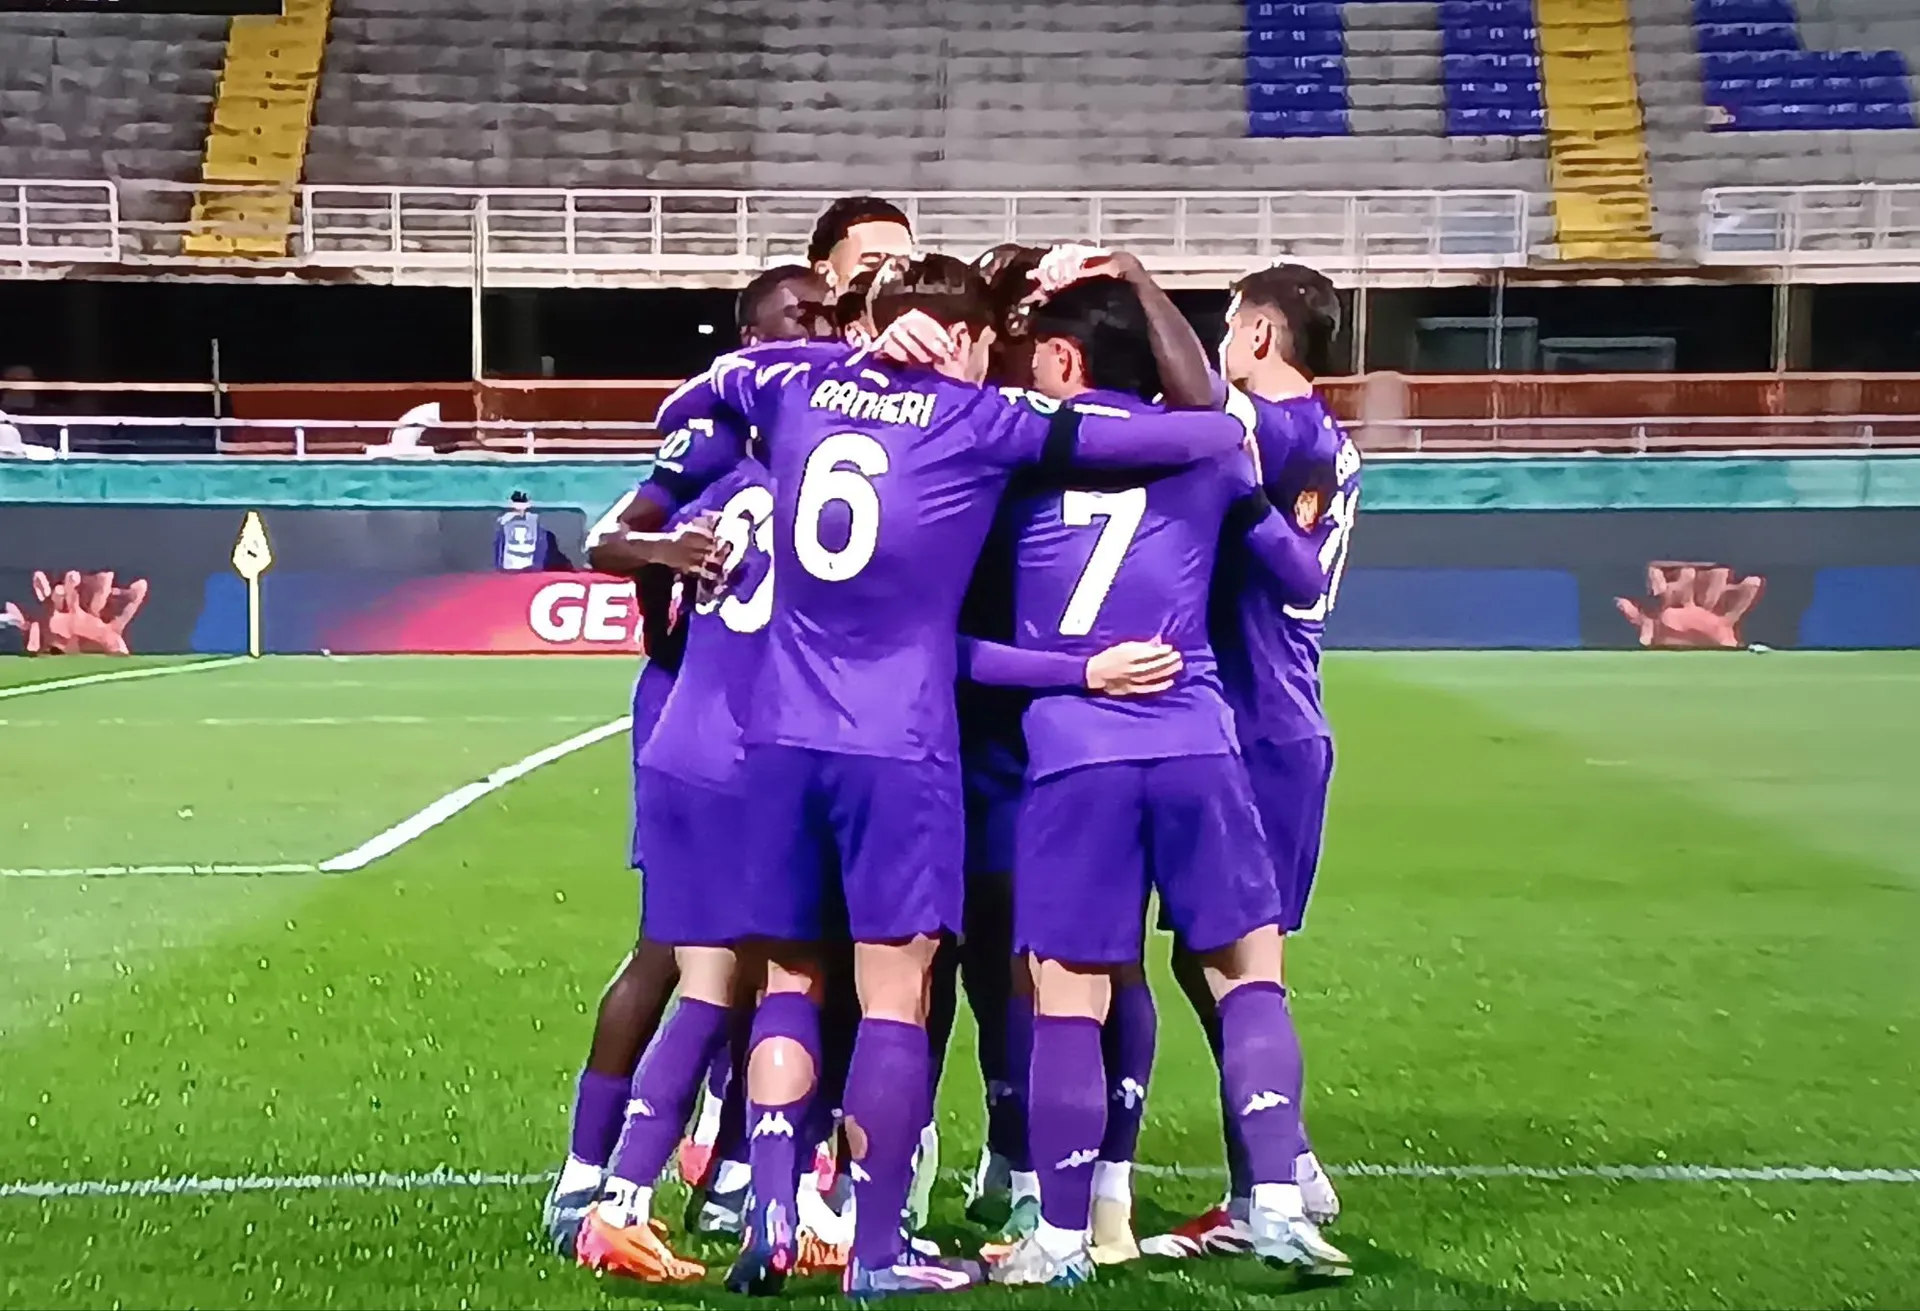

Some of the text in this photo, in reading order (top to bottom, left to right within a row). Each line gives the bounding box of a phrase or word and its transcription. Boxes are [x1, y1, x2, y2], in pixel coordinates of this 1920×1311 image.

[810, 379, 938, 428] RANIERI
[794, 431, 890, 582] 6
[530, 581, 645, 643] GE
[1059, 487, 1147, 636] 7
